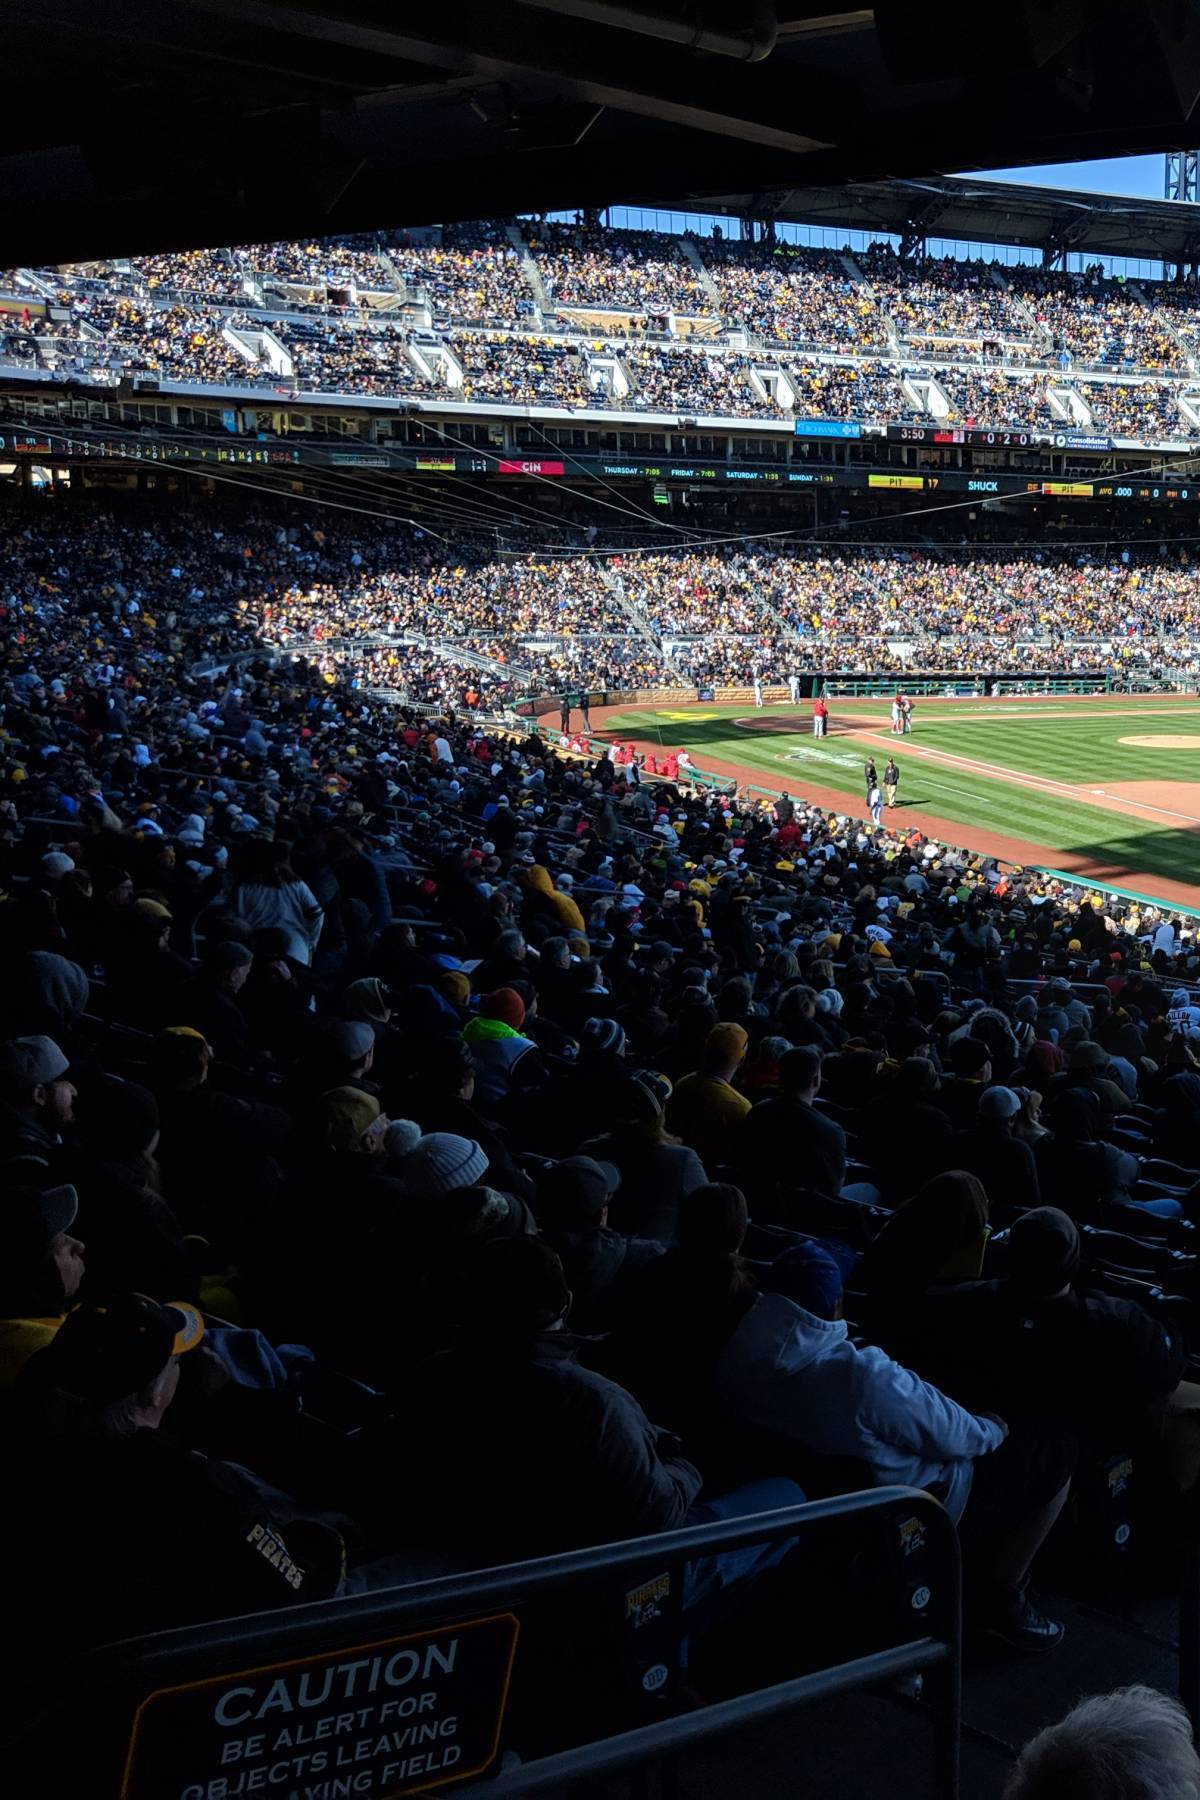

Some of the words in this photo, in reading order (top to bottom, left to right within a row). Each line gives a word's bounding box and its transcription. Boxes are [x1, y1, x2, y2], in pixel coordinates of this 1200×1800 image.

[901, 428, 925, 440] 3:50
[987, 432, 995, 444] 0
[1004, 434, 1010, 444] 2
[1020, 434, 1028, 445] 0
[1068, 436, 1108, 444] Consolidated
[521, 461, 542, 472] CIN
[604, 466, 638, 476] THURSDAY
[645, 468, 660, 476] 7:05
[671, 468, 694, 478] FRIDAY
[701, 470, 716, 478] 7:05
[726, 471, 758, 480] SATURDAY
[788, 474, 813, 482] SUNDAY
[889, 478, 902, 486] PIT
[928, 478, 938, 488] 17
[968, 480, 998, 492] SHUCK
[1115, 487, 1132, 497] .000
[246, 1523, 305, 1590] PIRATES
[212, 1639, 459, 1728] CAUTION
[220, 1734, 265, 1766] BE
[272, 1706, 378, 1752] ALERT
[379, 1690, 438, 1725] FOR
[180, 1750, 329, 1800] OBJECTS
[336, 1716, 458, 1766] LEAVING
[379, 1744, 462, 1786] FIELD
